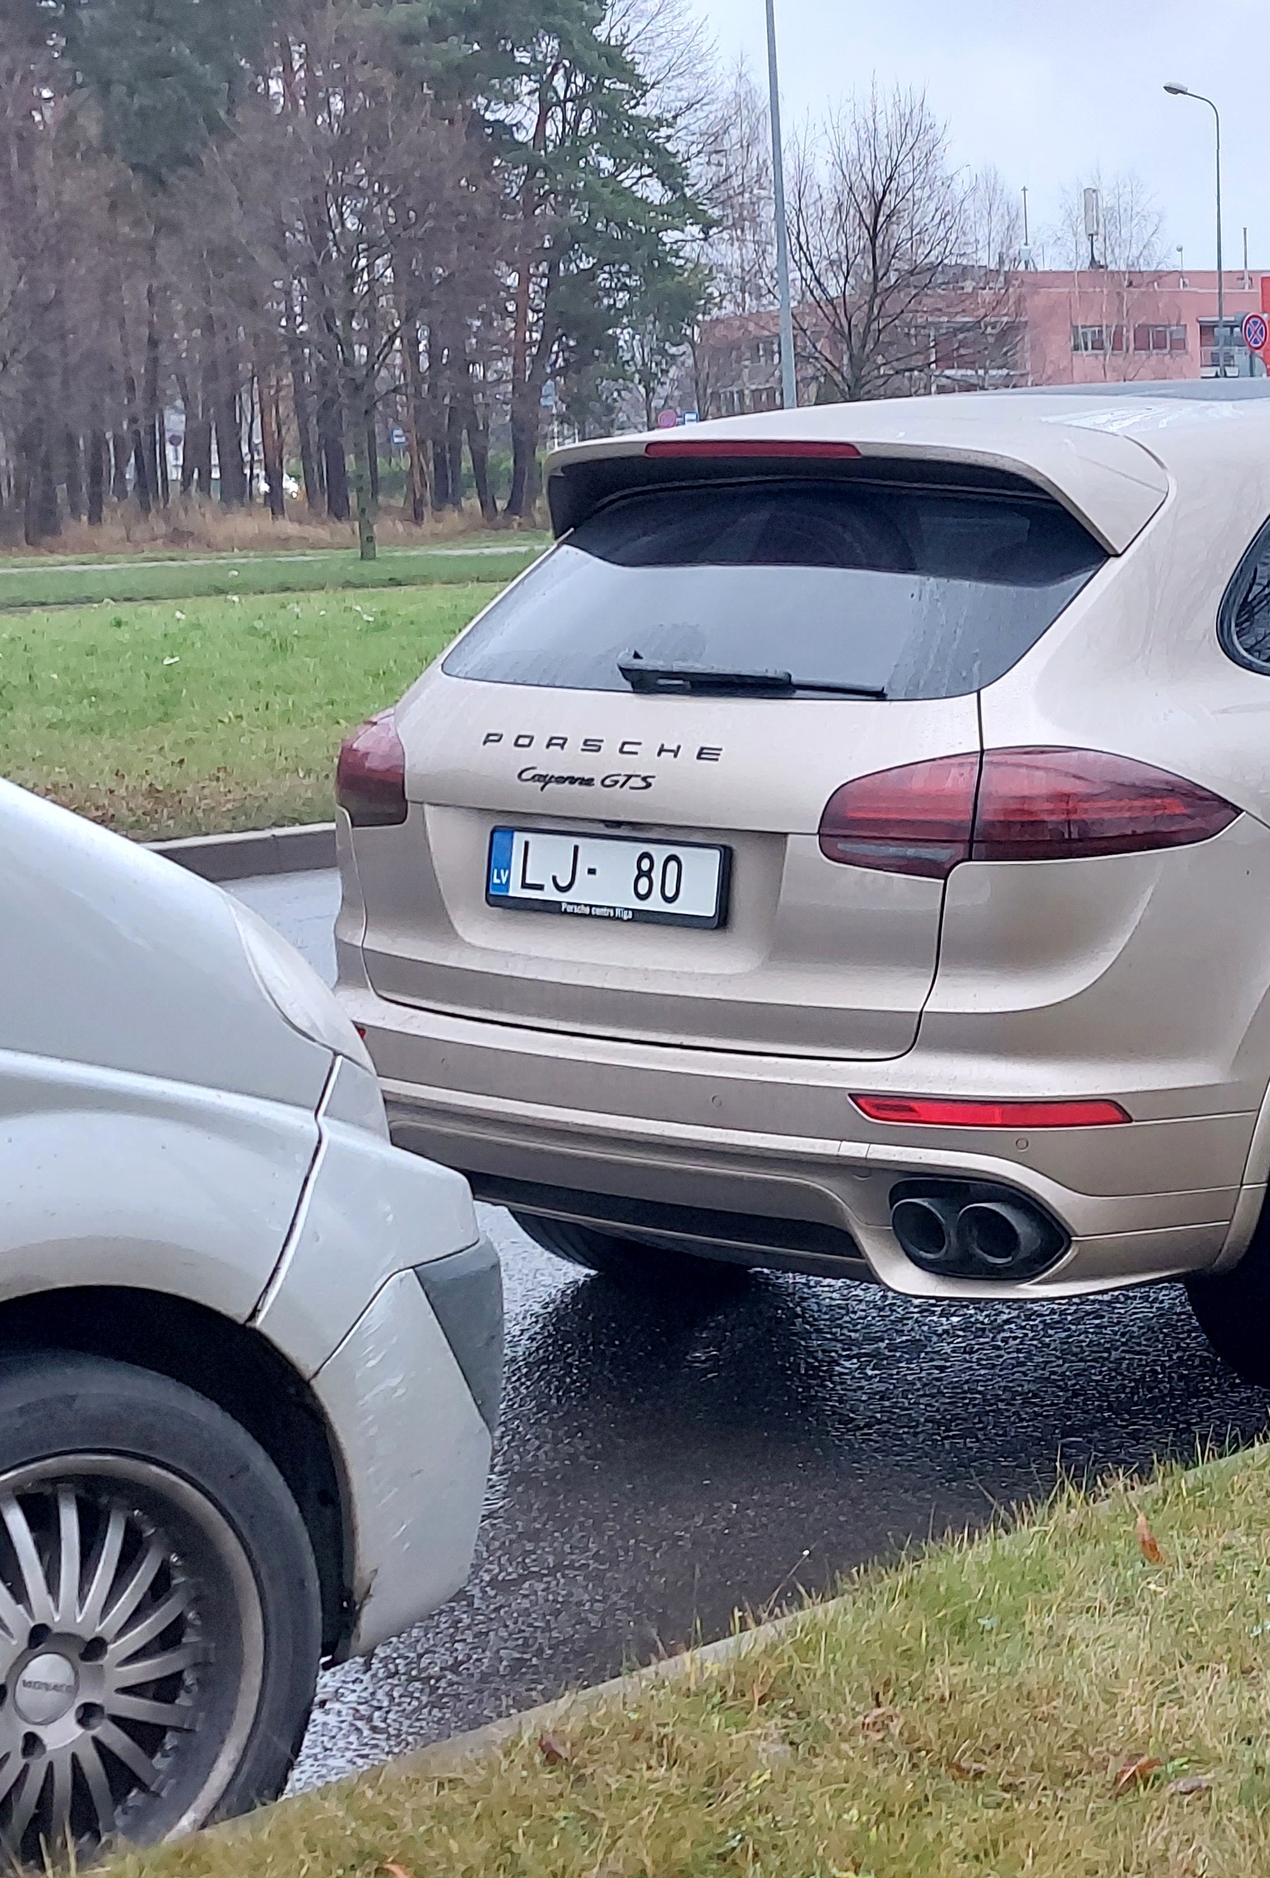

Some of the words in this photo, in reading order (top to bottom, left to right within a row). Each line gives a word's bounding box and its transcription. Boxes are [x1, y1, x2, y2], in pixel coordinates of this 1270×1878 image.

[482, 732, 723, 761] PORSCHE
[517, 767, 595, 792] Cayenne
[600, 773, 656, 790] GTS
[493, 868, 508, 884] LV
[633, 851, 683, 904] 80
